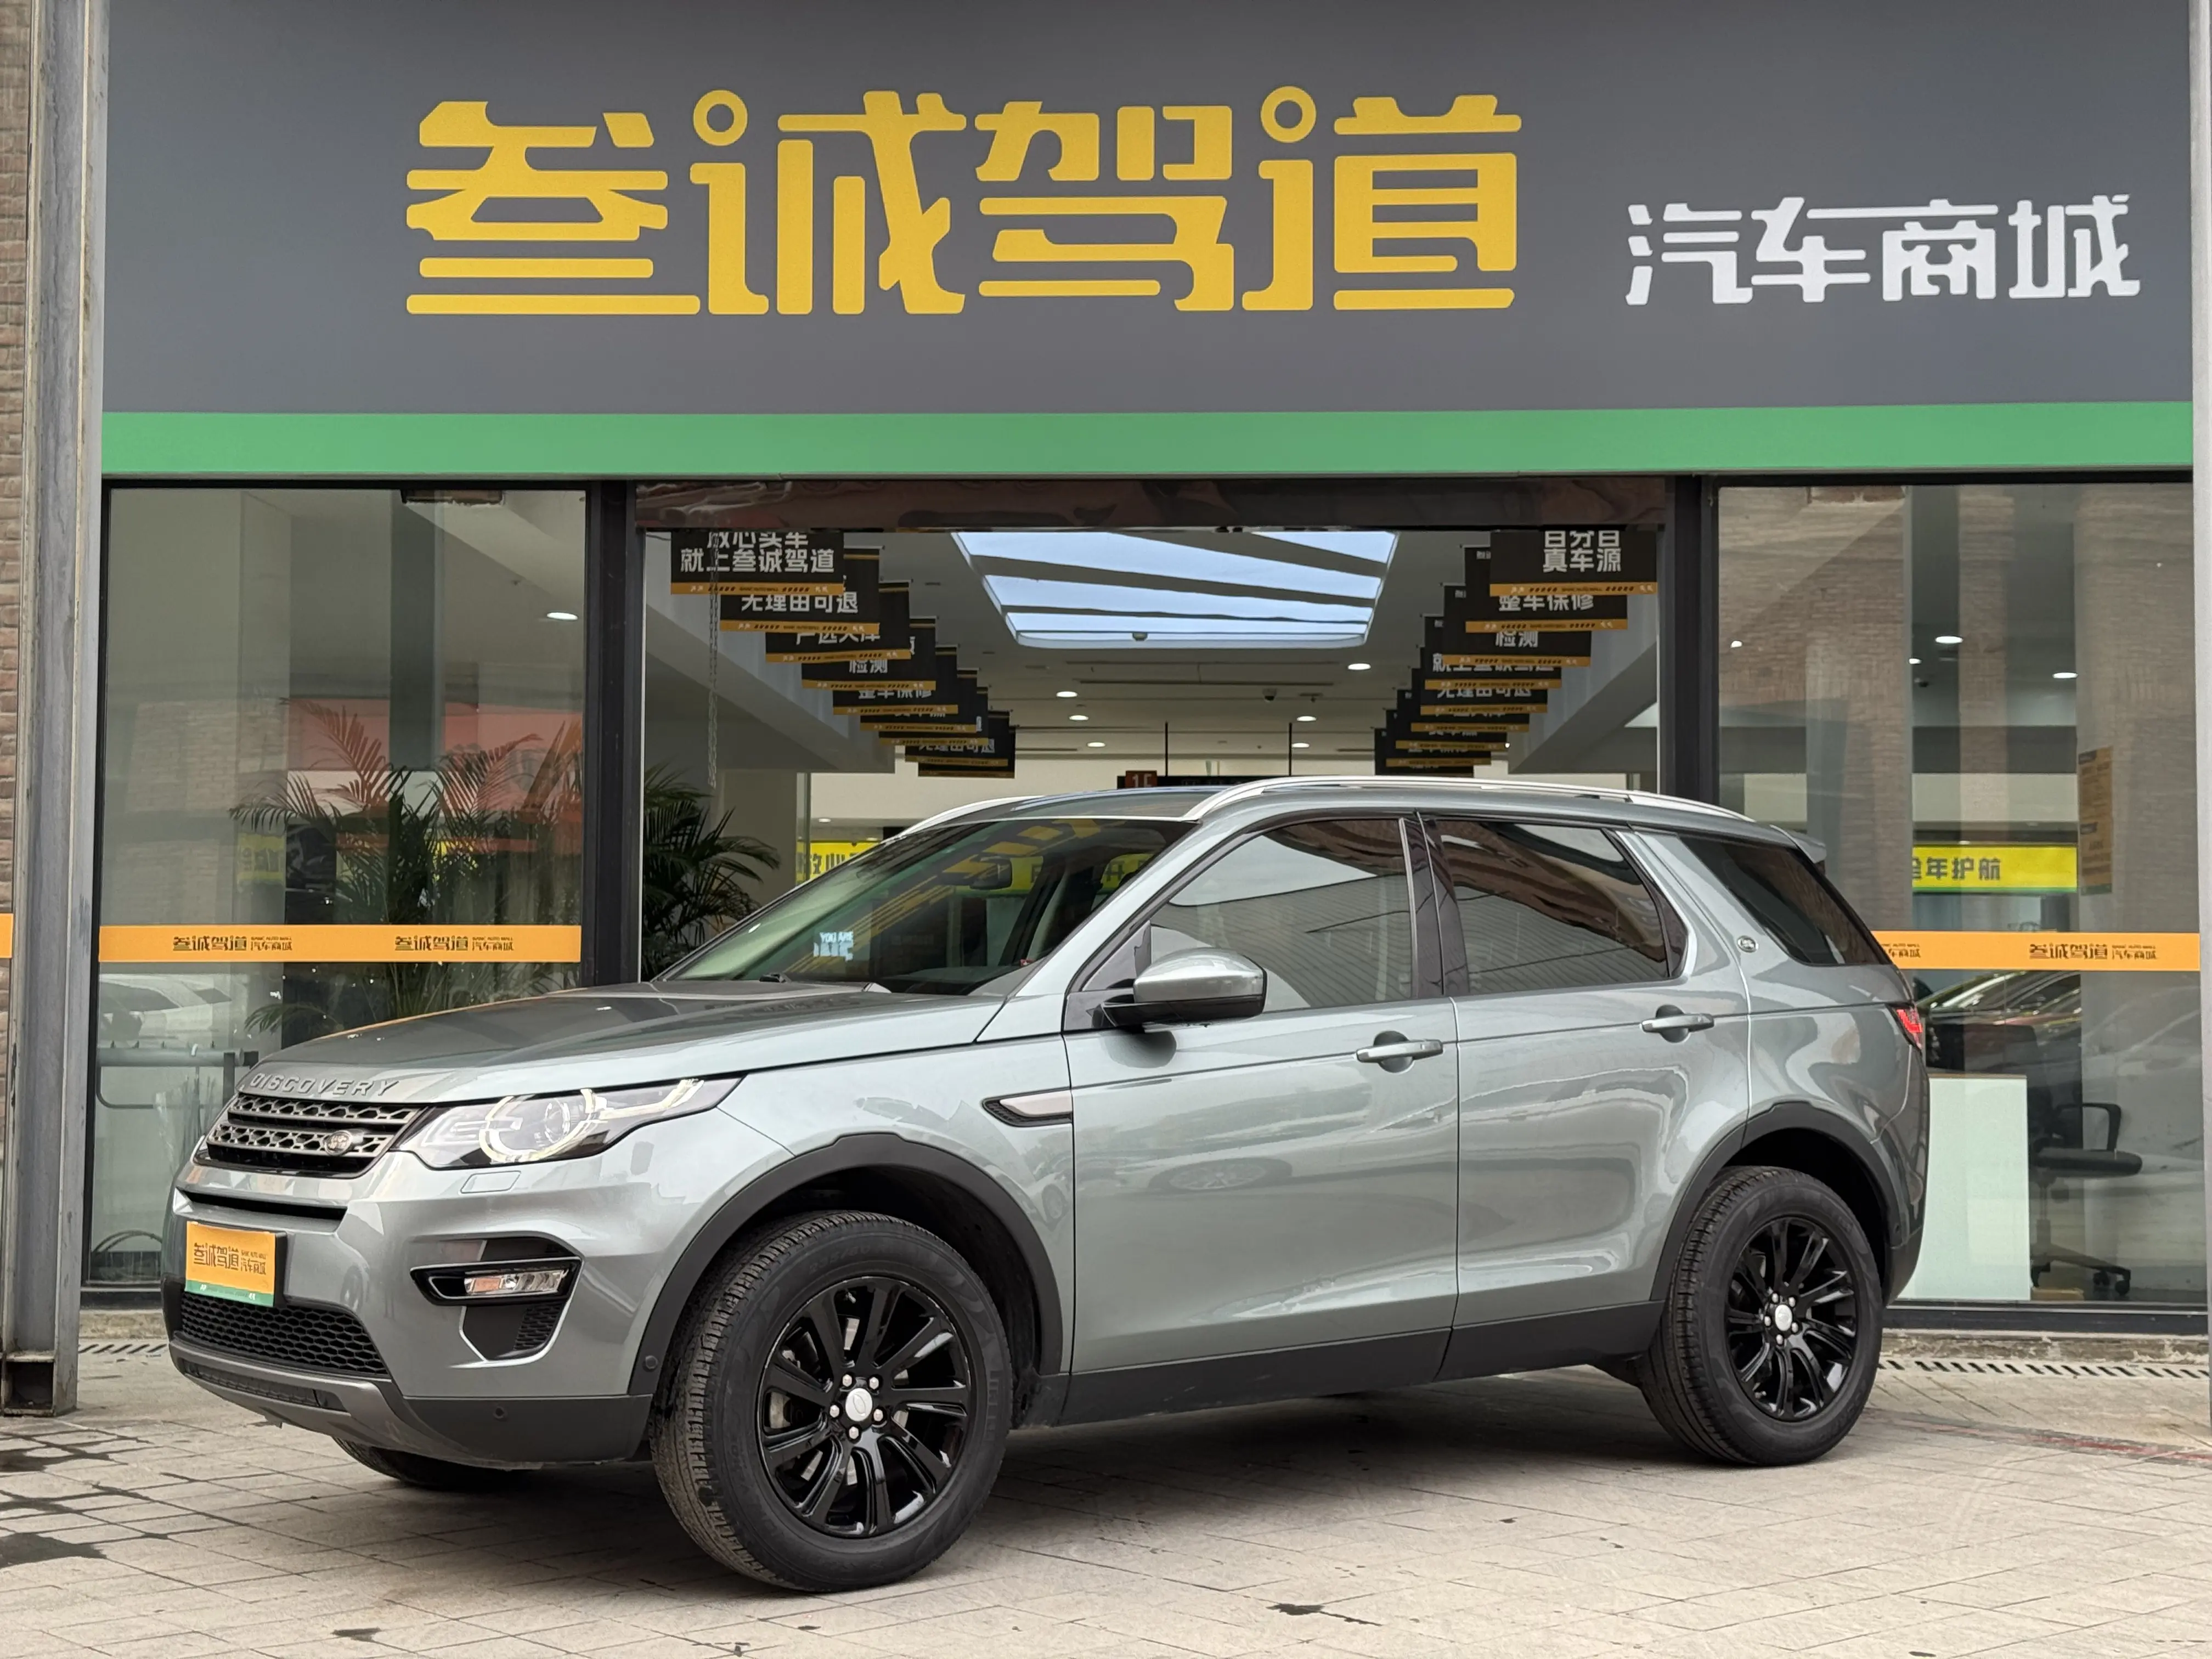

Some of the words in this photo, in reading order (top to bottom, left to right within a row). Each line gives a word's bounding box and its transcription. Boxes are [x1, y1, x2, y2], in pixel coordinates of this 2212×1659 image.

[408, 86, 1520, 314] 叁诚驾道
[1627, 196, 2139, 304] 汽车商城
[680, 548, 834, 573] 就上叁诚驾道
[1543, 548, 1622, 572] 真车源
[1496, 631, 1538, 647] 检测
[250, 1073, 399, 1096] DISCOVERY
